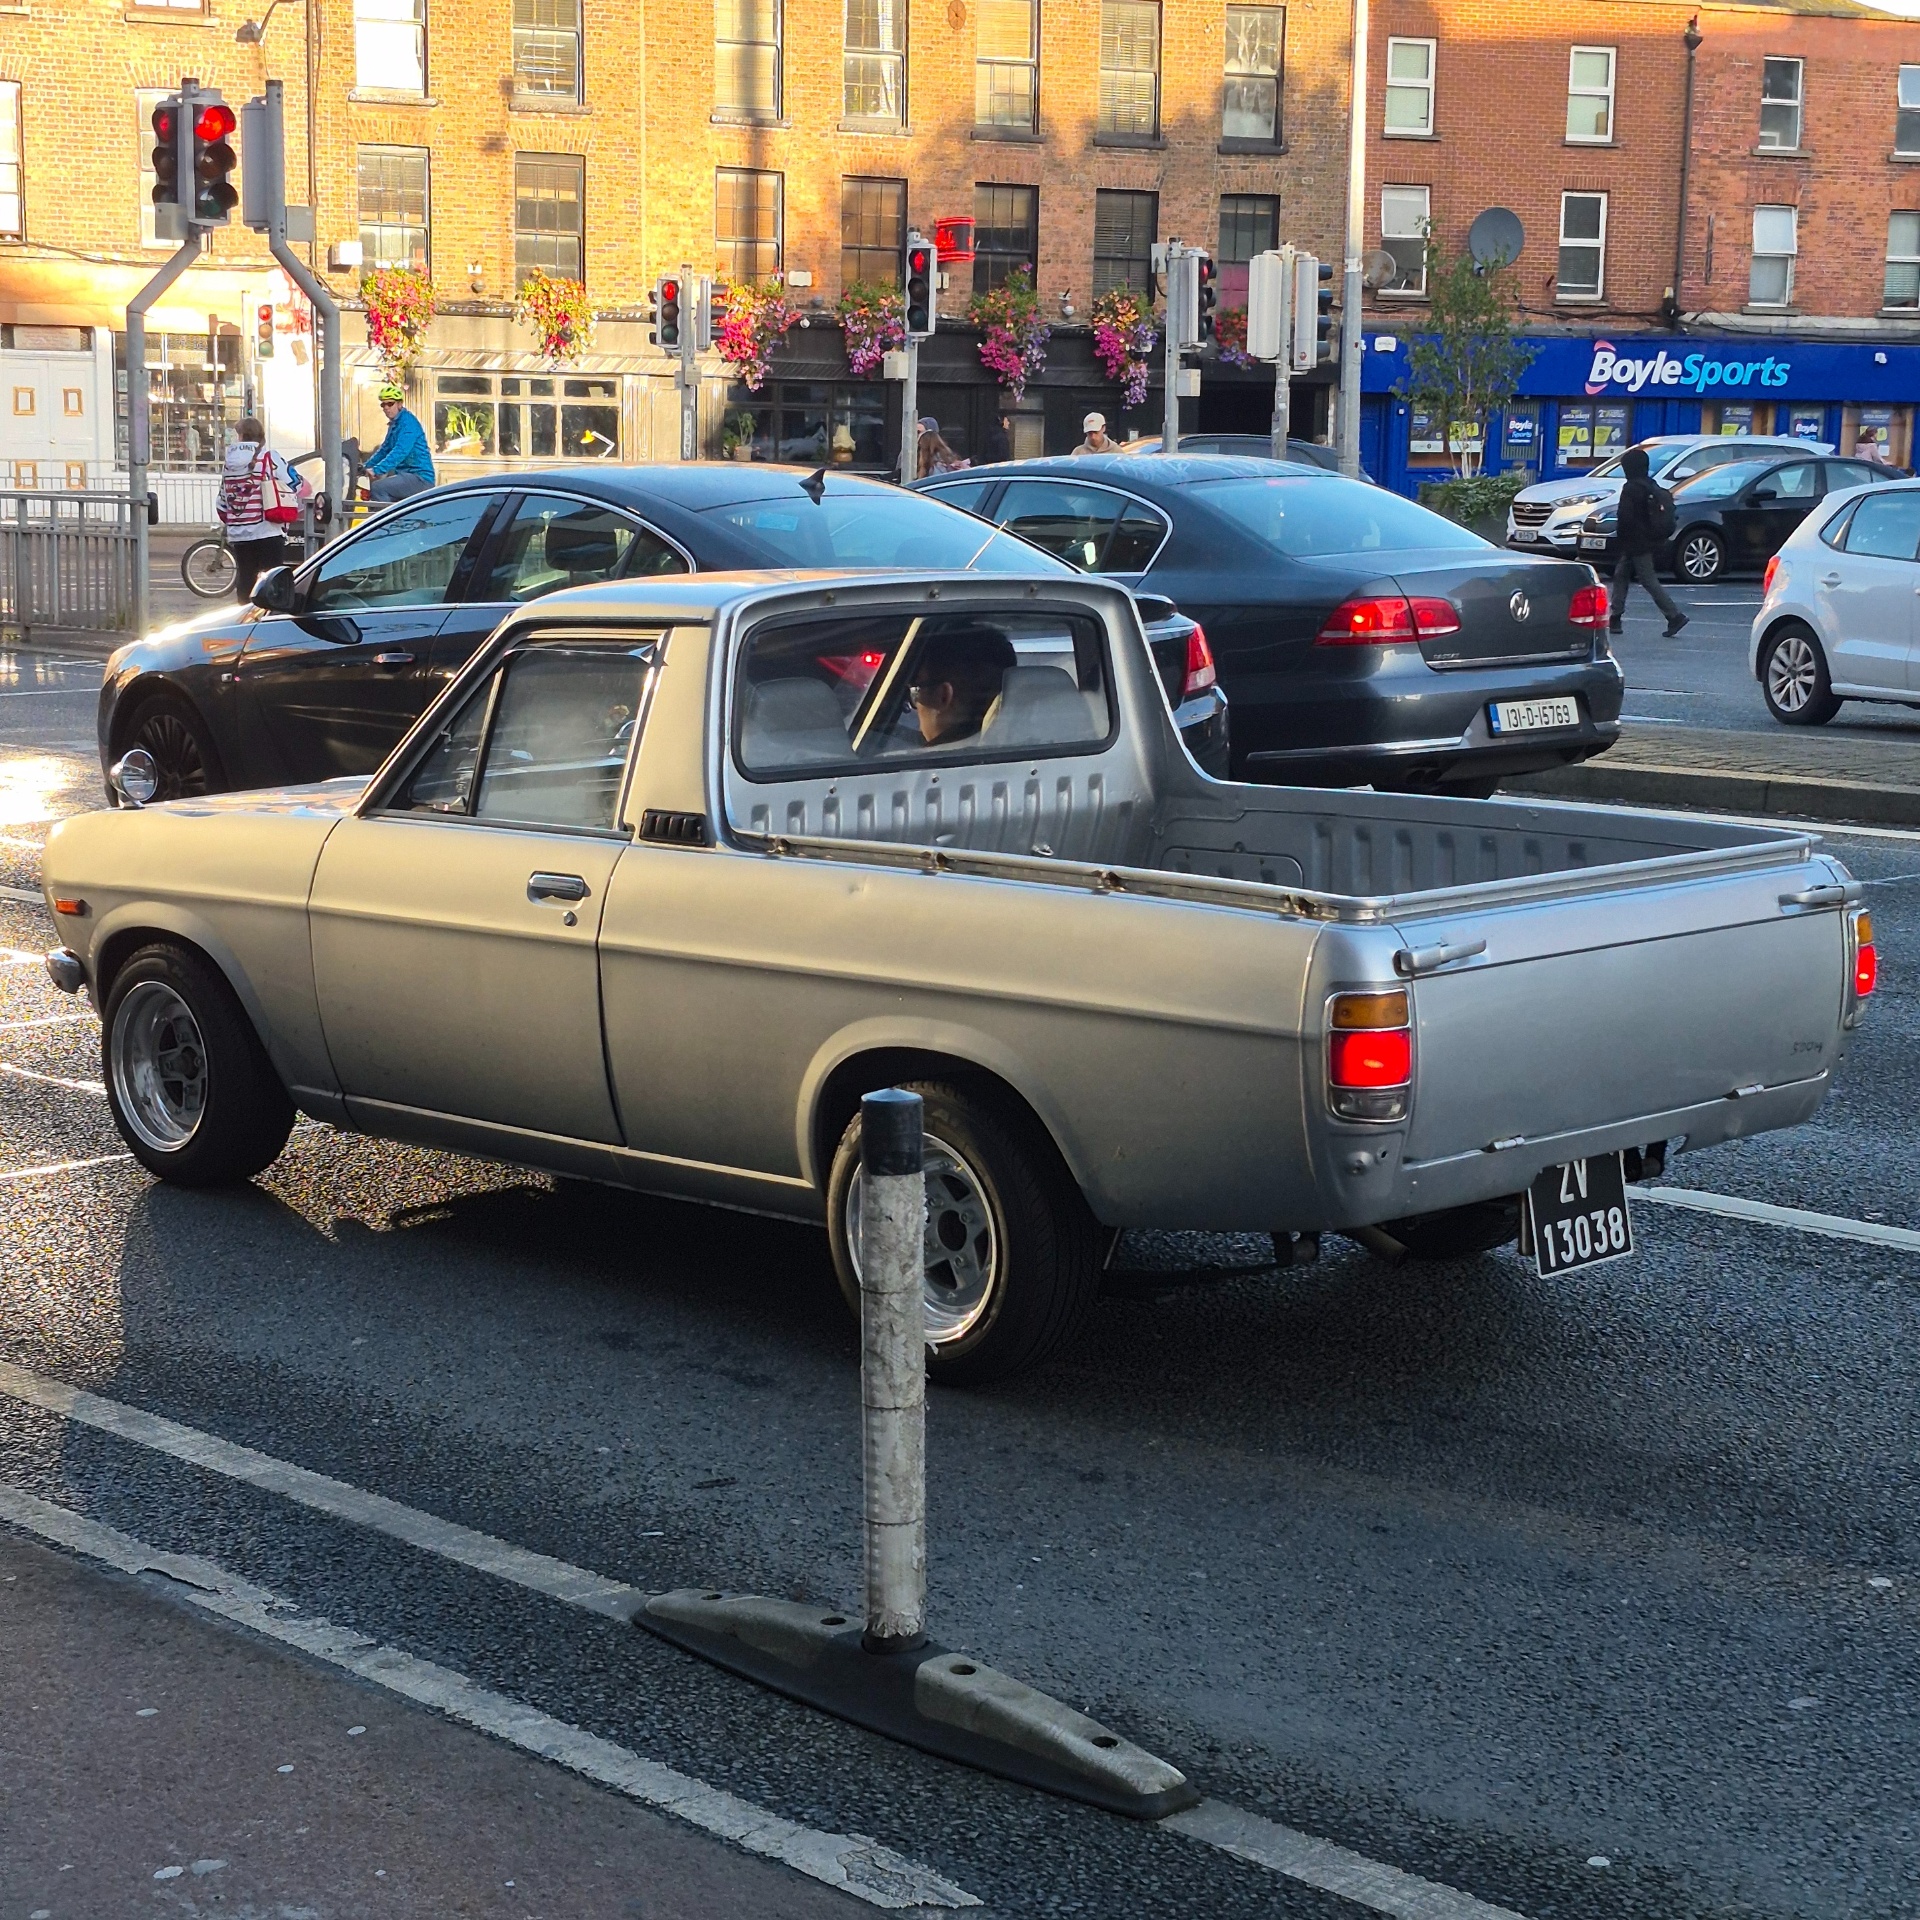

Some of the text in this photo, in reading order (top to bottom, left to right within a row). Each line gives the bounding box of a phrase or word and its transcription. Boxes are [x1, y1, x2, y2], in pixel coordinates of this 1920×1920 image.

[1589, 351, 1790, 393] BoyleSports
[1509, 420, 1533, 431] Boyle
[1507, 704, 1571, 728] 131-D-15769
[1556, 1158, 1588, 1204] ZV
[1543, 1206, 1625, 1268] 13038
